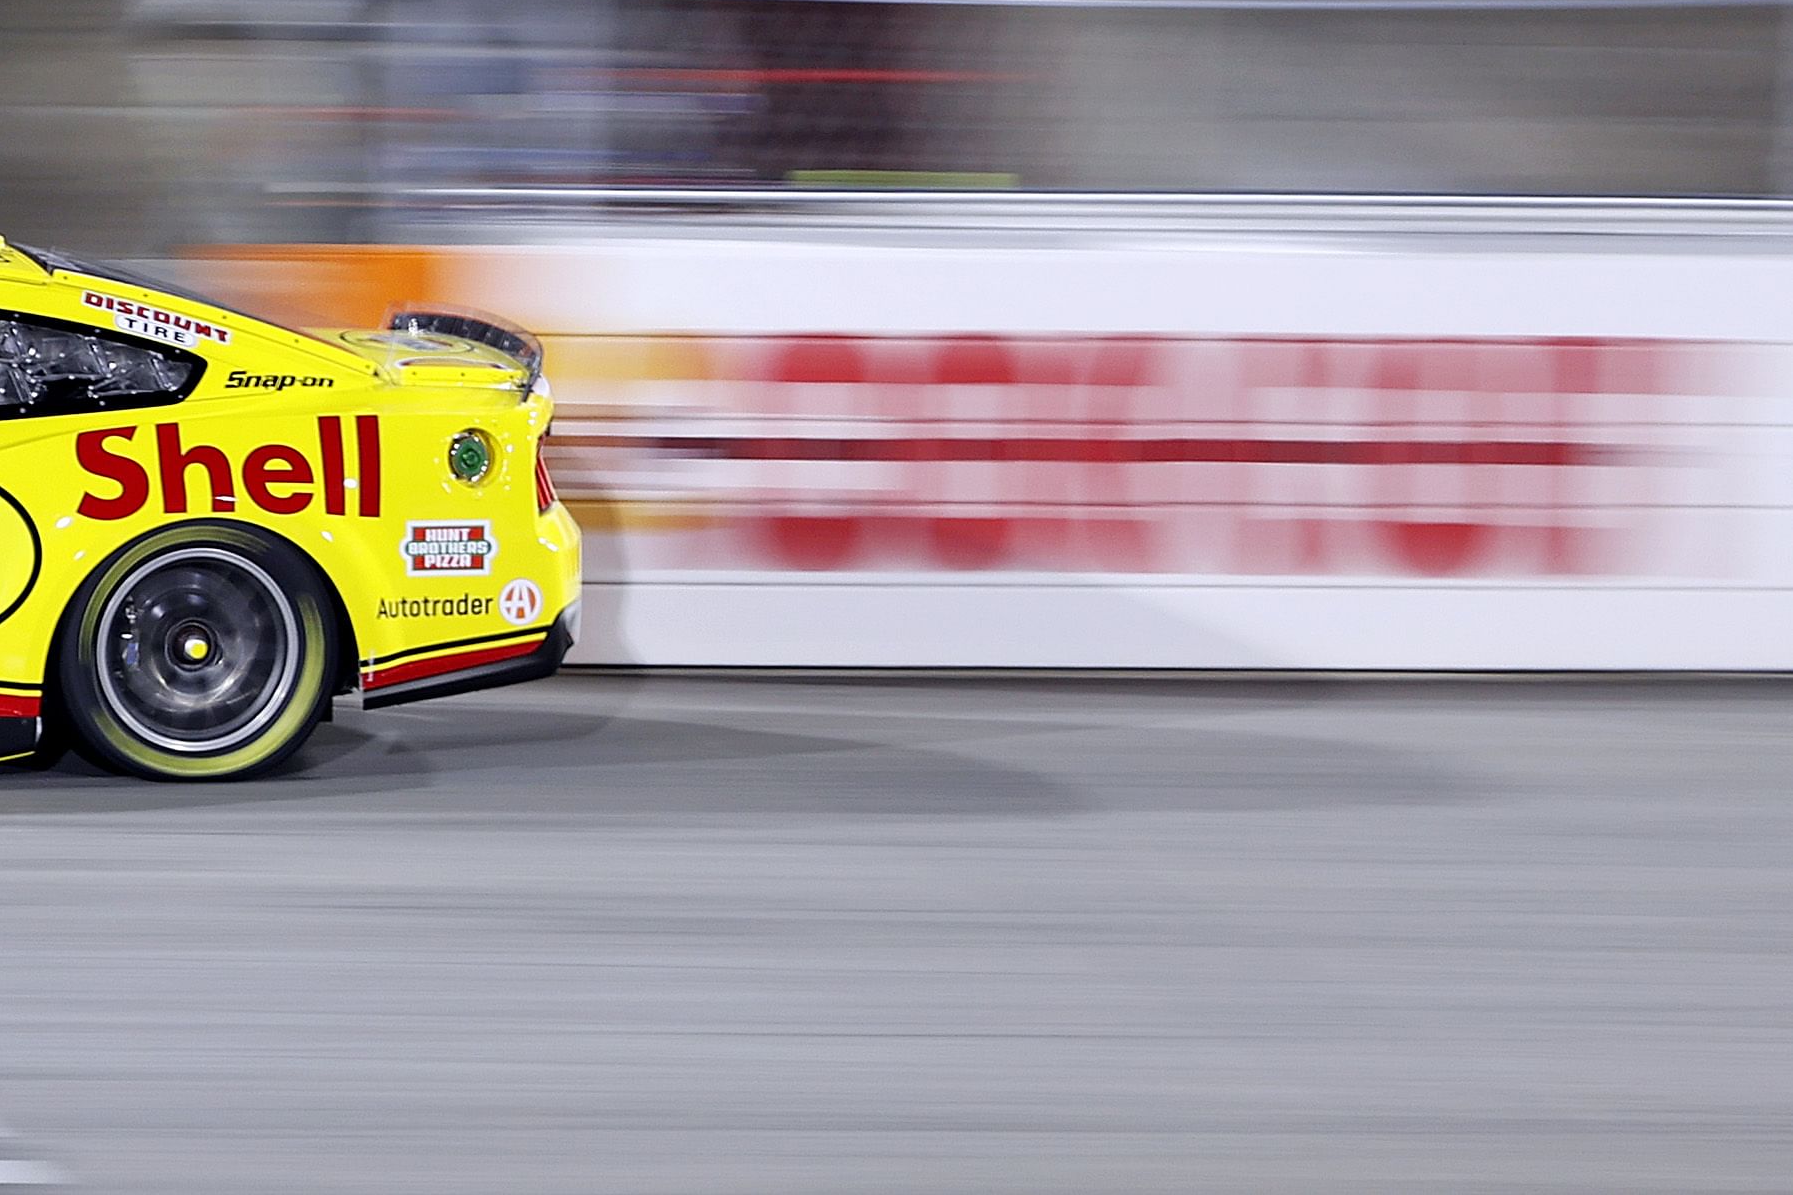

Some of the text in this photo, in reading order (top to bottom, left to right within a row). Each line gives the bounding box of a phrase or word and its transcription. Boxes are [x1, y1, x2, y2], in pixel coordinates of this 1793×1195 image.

[84, 292, 229, 342] DISCOUNT
[126, 317, 187, 344] TIRE
[225, 371, 334, 391] Snap-on
[76, 415, 380, 519] Shell
[425, 528, 471, 541] HUNT
[408, 542, 489, 555] BROTHERS
[424, 554, 472, 568] PIZZA
[378, 594, 493, 618] Autotrader
